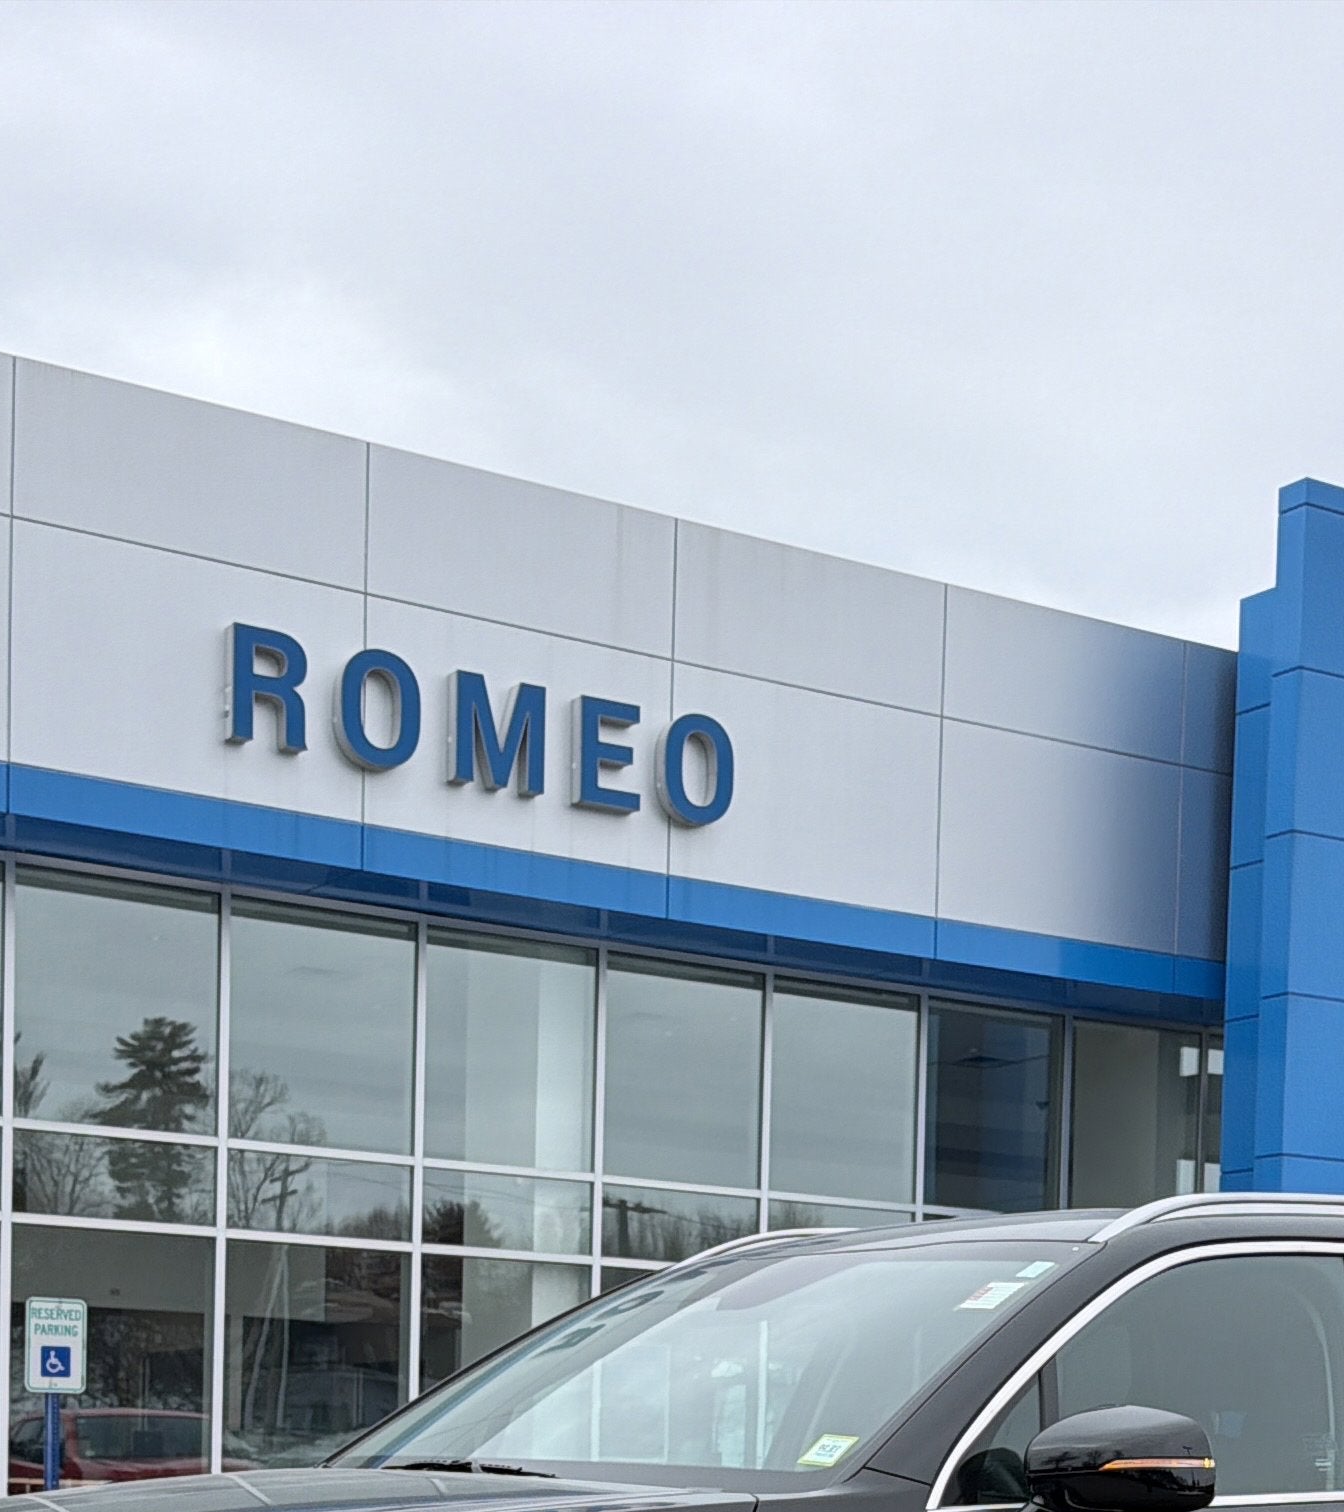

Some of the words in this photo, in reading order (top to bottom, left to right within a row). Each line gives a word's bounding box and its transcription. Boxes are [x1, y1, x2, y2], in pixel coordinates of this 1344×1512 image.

[223, 621, 734, 828] ROMEO
[31, 1307, 82, 1321] RESERVED
[34, 1323, 79, 1337] PARKING
